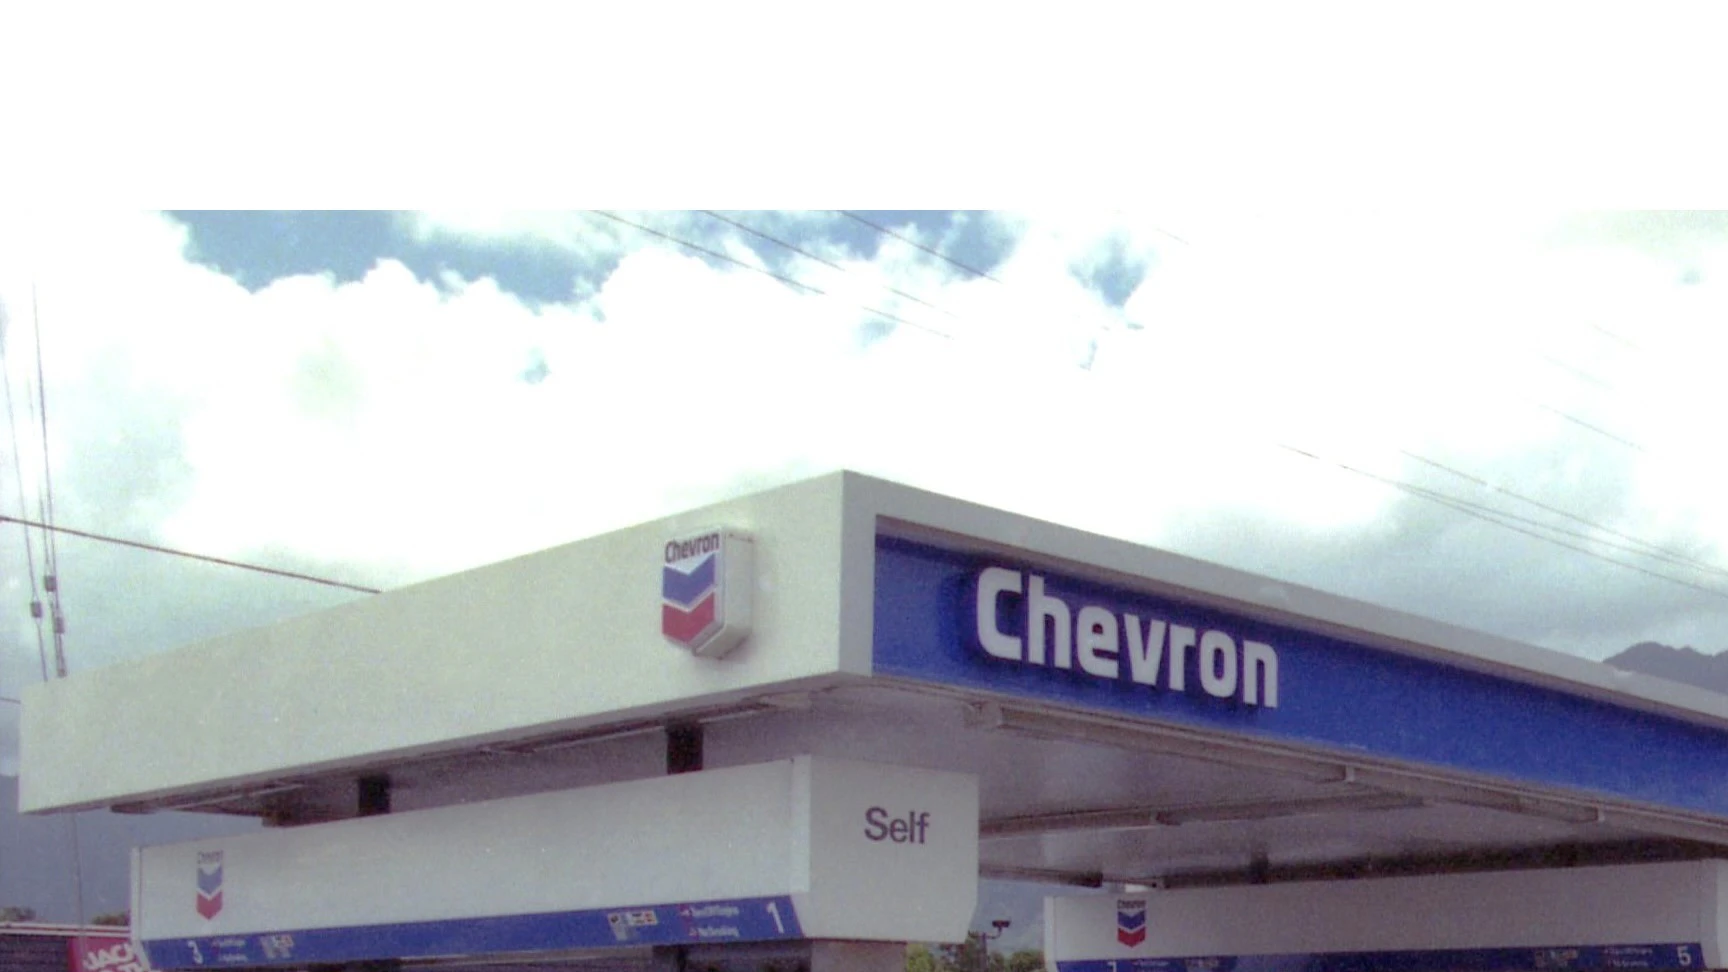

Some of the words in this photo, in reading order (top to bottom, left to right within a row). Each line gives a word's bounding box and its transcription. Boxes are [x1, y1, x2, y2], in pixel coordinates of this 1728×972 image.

[664, 533, 720, 563] Chevron
[976, 566, 1278, 708] Chevron
[864, 806, 931, 844] Self
[766, 902, 785, 934] 1
[83, 942, 136, 970] JAC
[1677, 946, 1692, 967] 5
